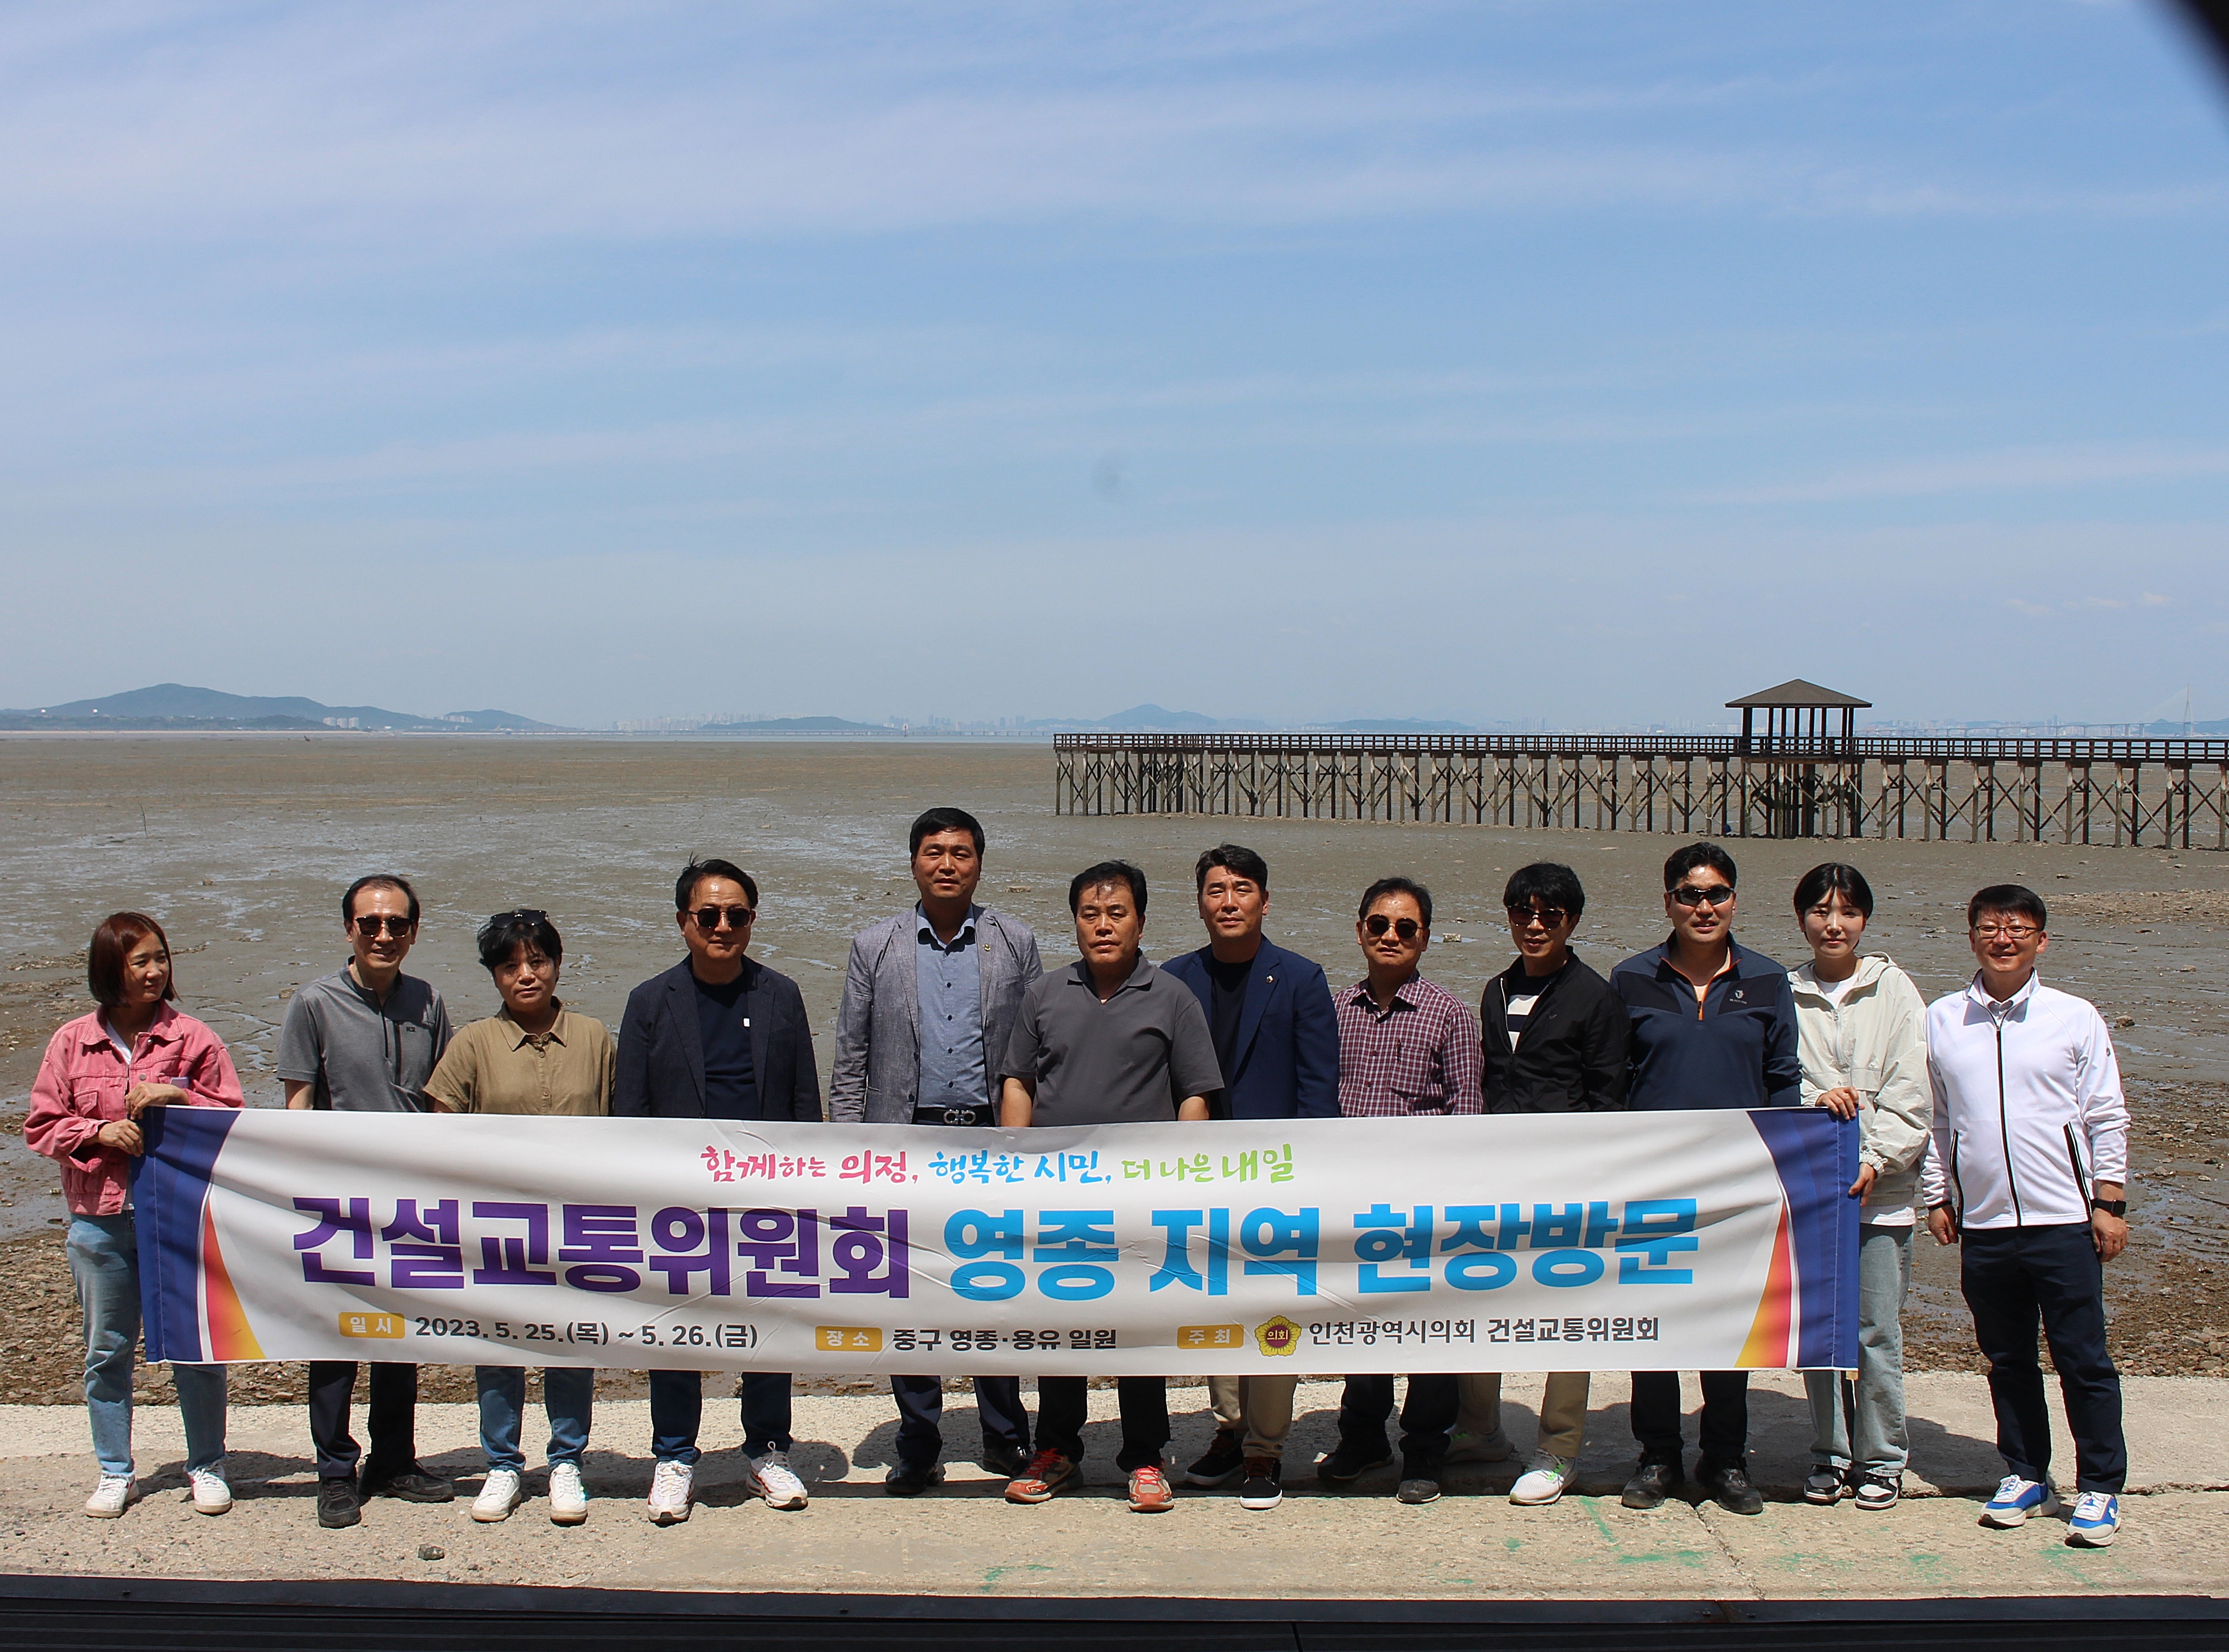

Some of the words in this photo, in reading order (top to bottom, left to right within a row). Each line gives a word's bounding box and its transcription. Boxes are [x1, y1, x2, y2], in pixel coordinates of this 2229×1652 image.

[701, 1145, 826, 1182] 함께하는
[839, 1150, 918, 1184] 의정,
[928, 1150, 1024, 1184] 행복한
[1034, 1150, 1111, 1184] 시민,
[1122, 1159, 1150, 1180] 더
[1161, 1153, 1214, 1182] 나은
[1222, 1144, 1294, 1183] 내일
[292, 1197, 909, 1299] 건설교통위원회
[944, 1209, 1119, 1301] 영종
[1149, 1208, 1320, 1296] 지역
[1353, 1198, 1699, 1294] 현장방문
[893, 1329, 942, 1351] 중구
[1069, 1329, 1117, 1349] 일원
[1267, 1330, 1288, 1340] 의회
[1308, 1320, 1475, 1345] 인천광역시의회
[1487, 1317, 1659, 1343] 건설교통위원회
